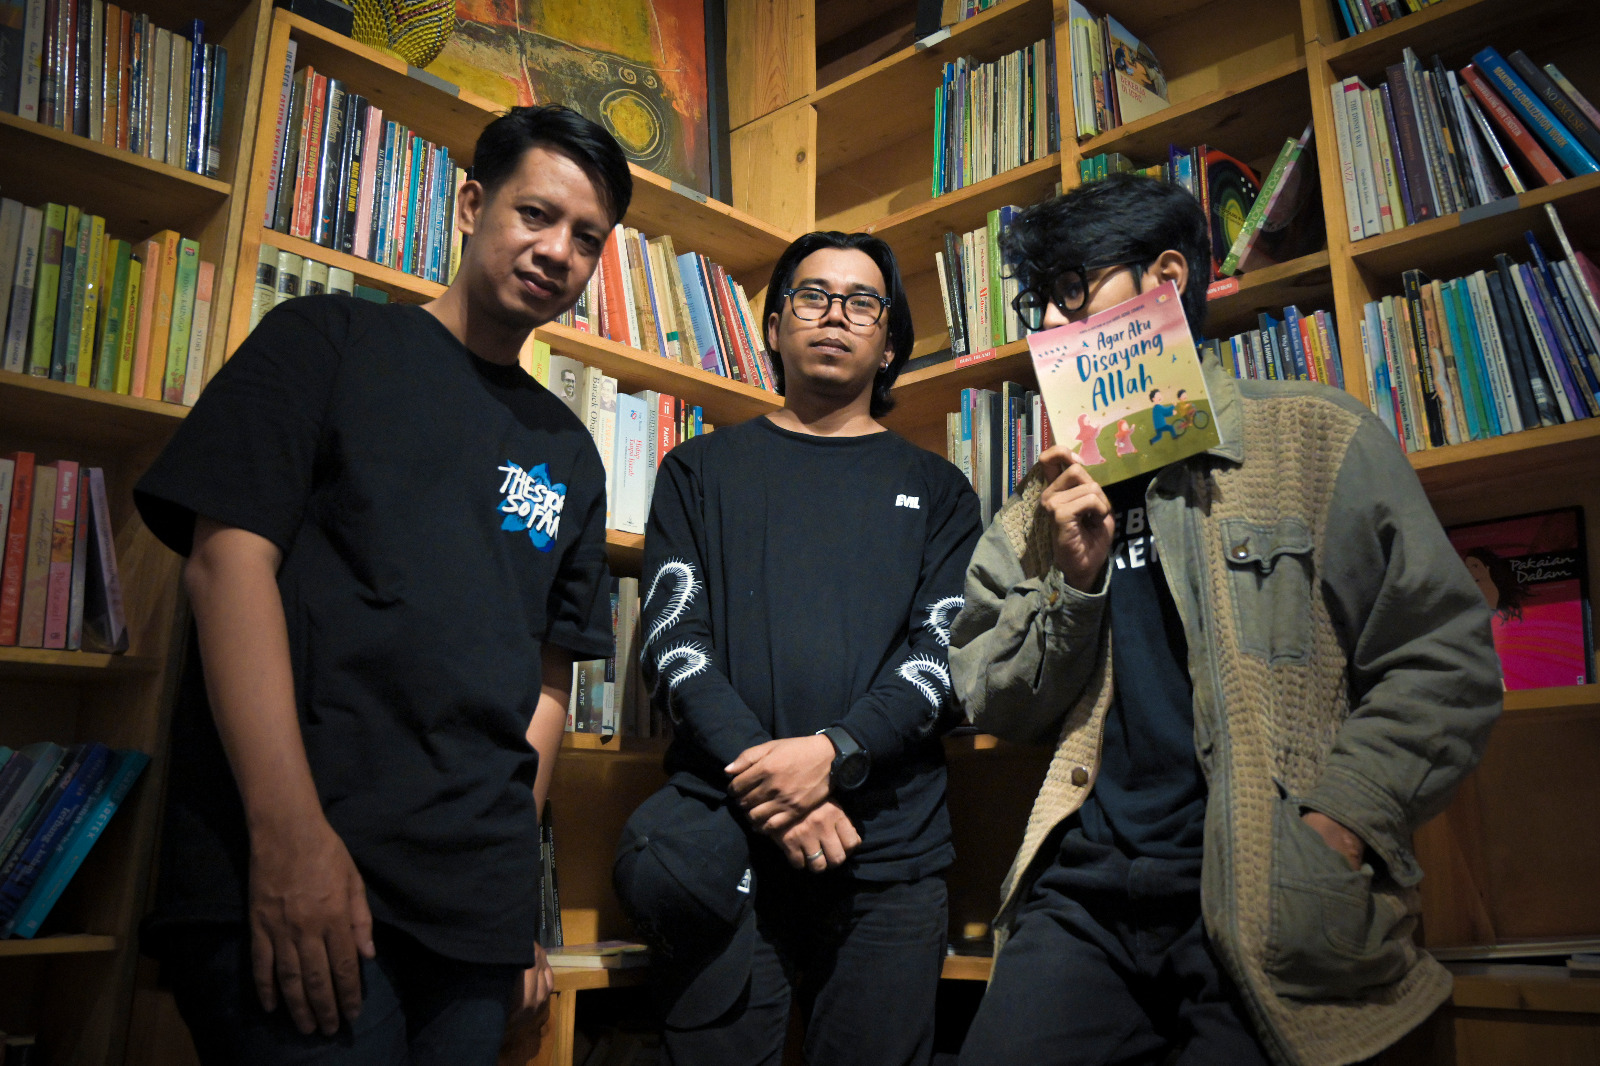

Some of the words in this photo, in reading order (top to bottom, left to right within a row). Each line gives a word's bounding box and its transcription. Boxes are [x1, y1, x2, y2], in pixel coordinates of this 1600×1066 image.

[1492, 64, 1517, 91] MAKING
[1511, 86, 1553, 132] GLOBALIZATION
[1546, 126, 1568, 149] WORK
[1542, 85, 1558, 103] NO
[310, 105, 321, 144] PRAHARA
[350, 161, 360, 178] BACK
[349, 179, 358, 196] DOOR
[1413, 298, 1424, 336] FUNDAMENTALS
[1098, 331, 1124, 350] Agar
[1128, 320, 1151, 340] Aku
[1261, 330, 1269, 344] TIGA
[1076, 333, 1163, 382] Disayang
[1263, 344, 1272, 363] TAHUN
[589, 376, 601, 407] Barack
[1092, 363, 1153, 410] Allah
[587, 410, 598, 439] Obam
[1510, 556, 1575, 572] Pakaian
[1516, 570, 1572, 584] Dalam
